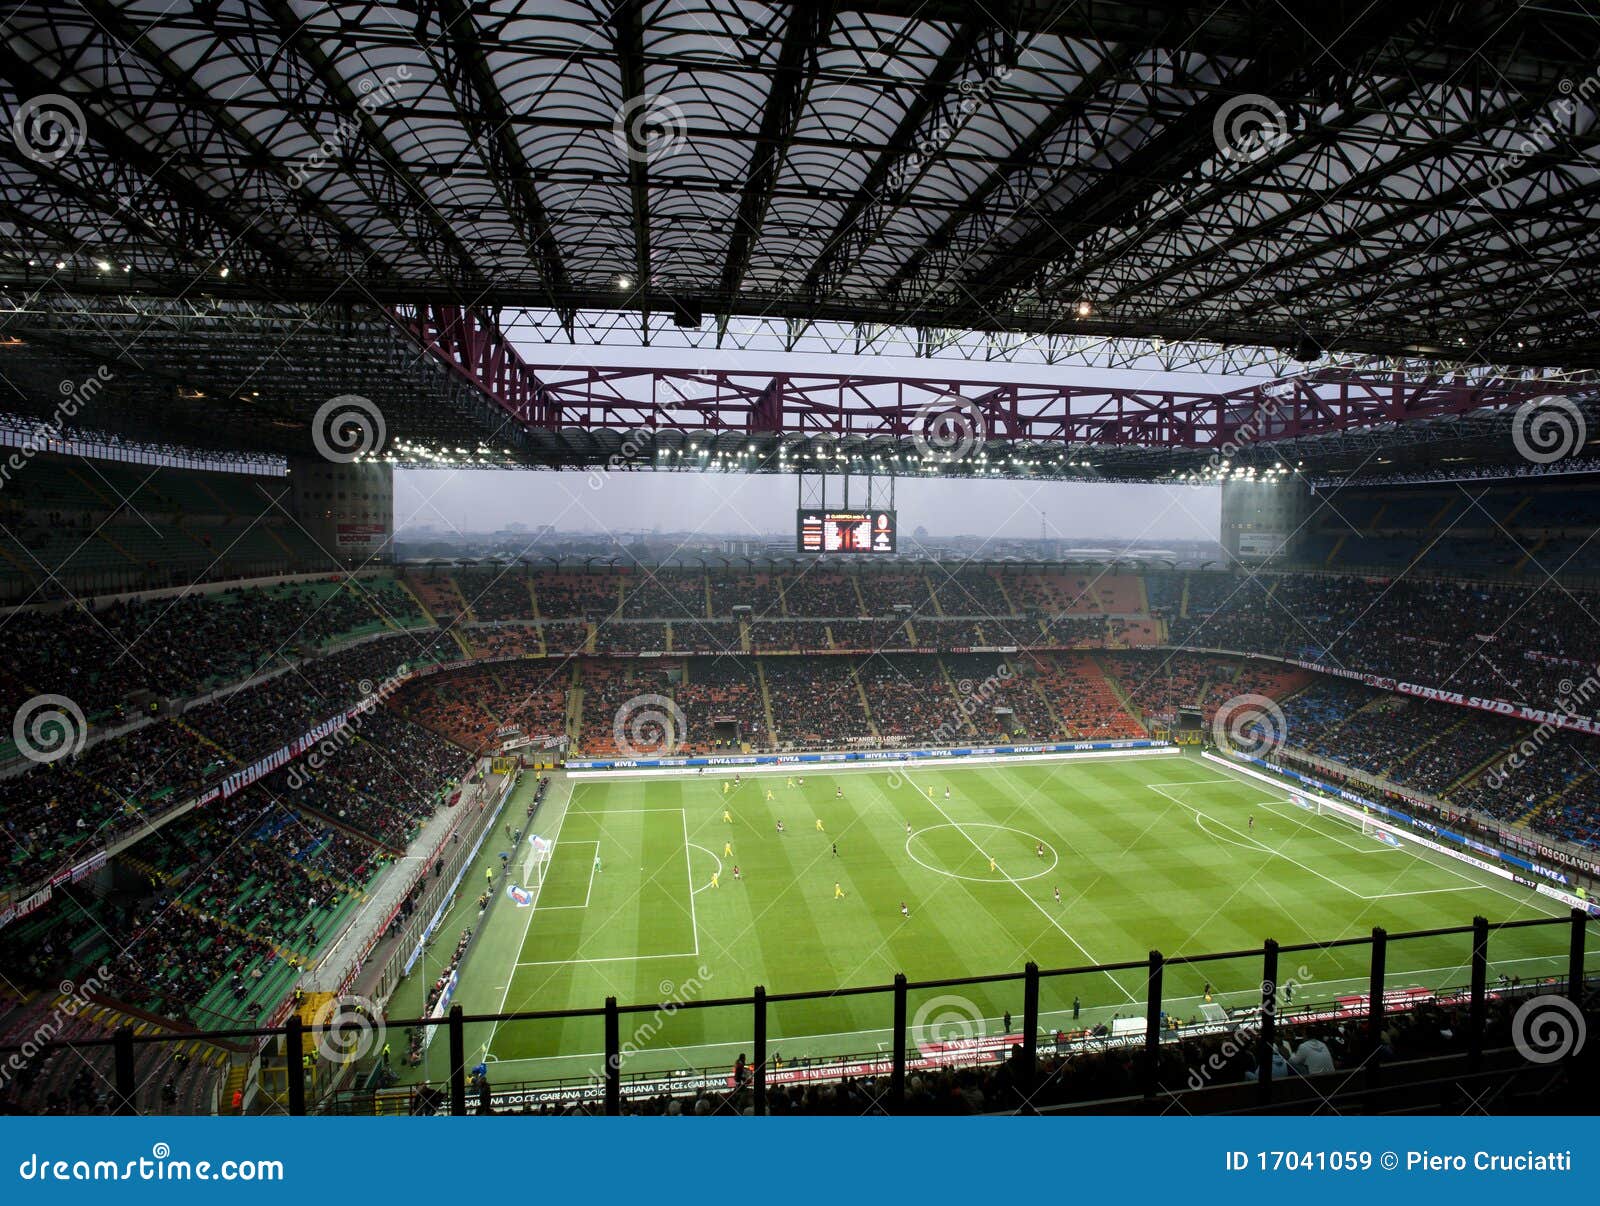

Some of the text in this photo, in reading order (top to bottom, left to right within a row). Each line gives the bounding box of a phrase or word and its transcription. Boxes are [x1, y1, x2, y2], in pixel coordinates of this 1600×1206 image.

[1397, 682, 1464, 704] CURVA
[1468, 696, 1514, 714] SUD
[222, 745, 292, 799] ALTERNATIVA
[1532, 863, 1569, 884] NIVEA
[1562, 895, 1587, 911] Audi
[821, 1063, 863, 1076] Emirates
